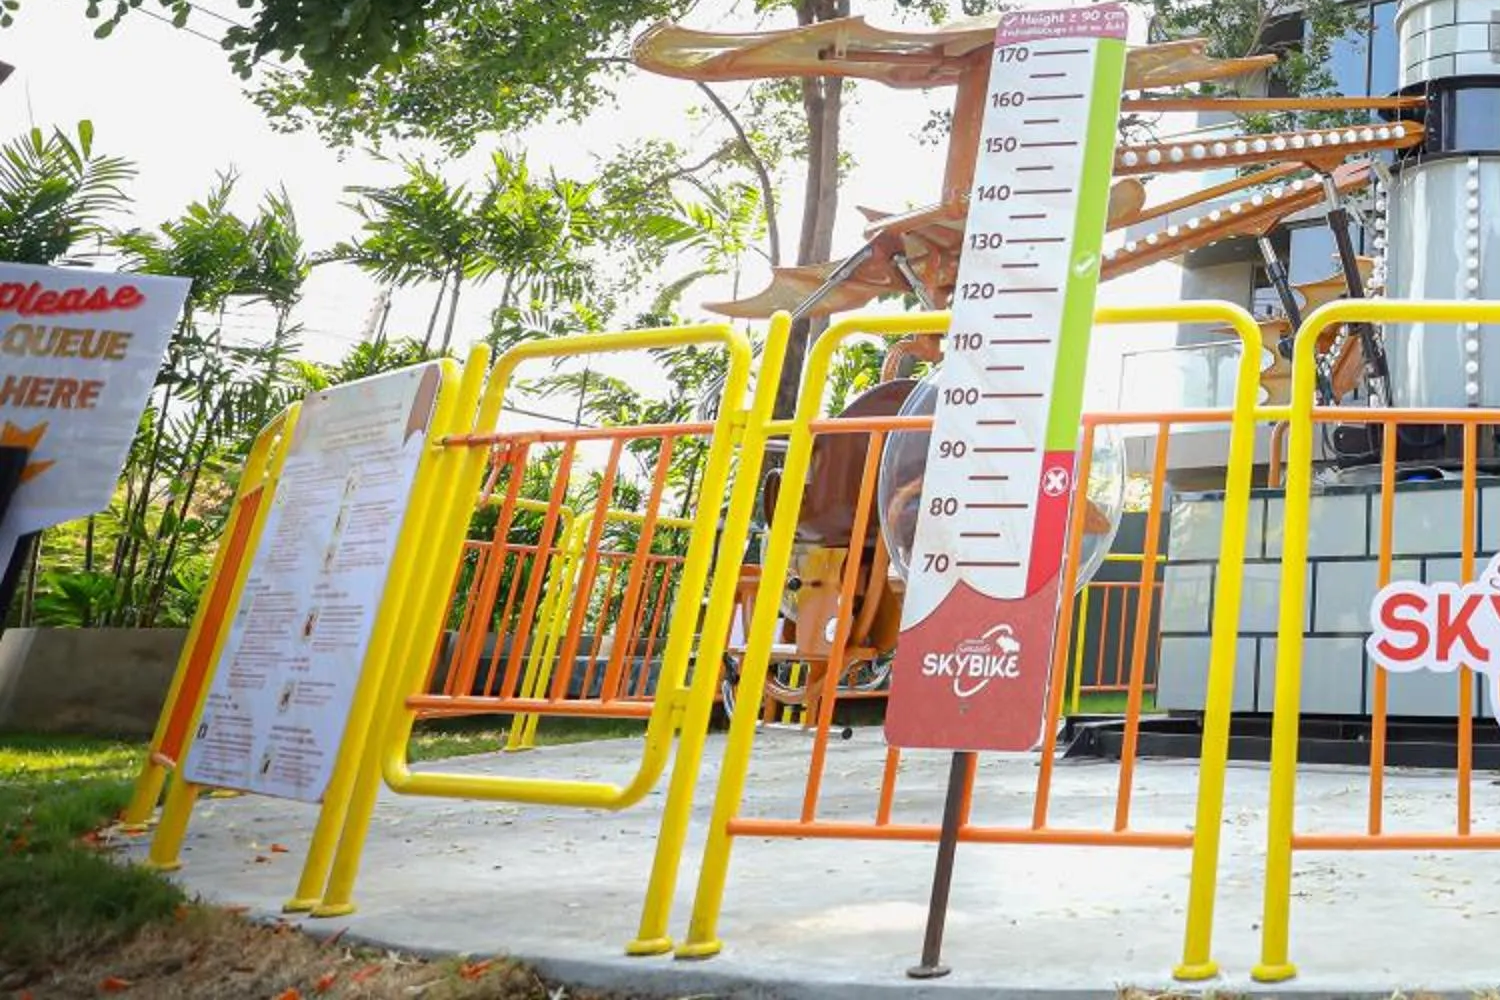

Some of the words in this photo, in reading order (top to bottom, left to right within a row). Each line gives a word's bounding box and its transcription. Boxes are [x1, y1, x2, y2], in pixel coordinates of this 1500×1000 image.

[1021, 13, 1065, 26] Height
[1081, 10, 1101, 21] 90
[1104, 11, 1125, 19] cm
[998, 47, 1029, 62] 170
[992, 92, 1024, 108] 160
[985, 137, 1017, 152] 150
[977, 185, 1010, 201] 140
[970, 233, 1003, 249] 130
[961, 283, 995, 299] 120
[1, 323, 134, 361] QUEUE
[953, 333, 983, 350] 110
[0, 375, 105, 409] HERE
[944, 387, 979, 405] 100
[940, 440, 967, 458] 90
[929, 497, 958, 516] 80
[923, 554, 949, 573] 70
[922, 653, 1020, 678] SKYBIKE
